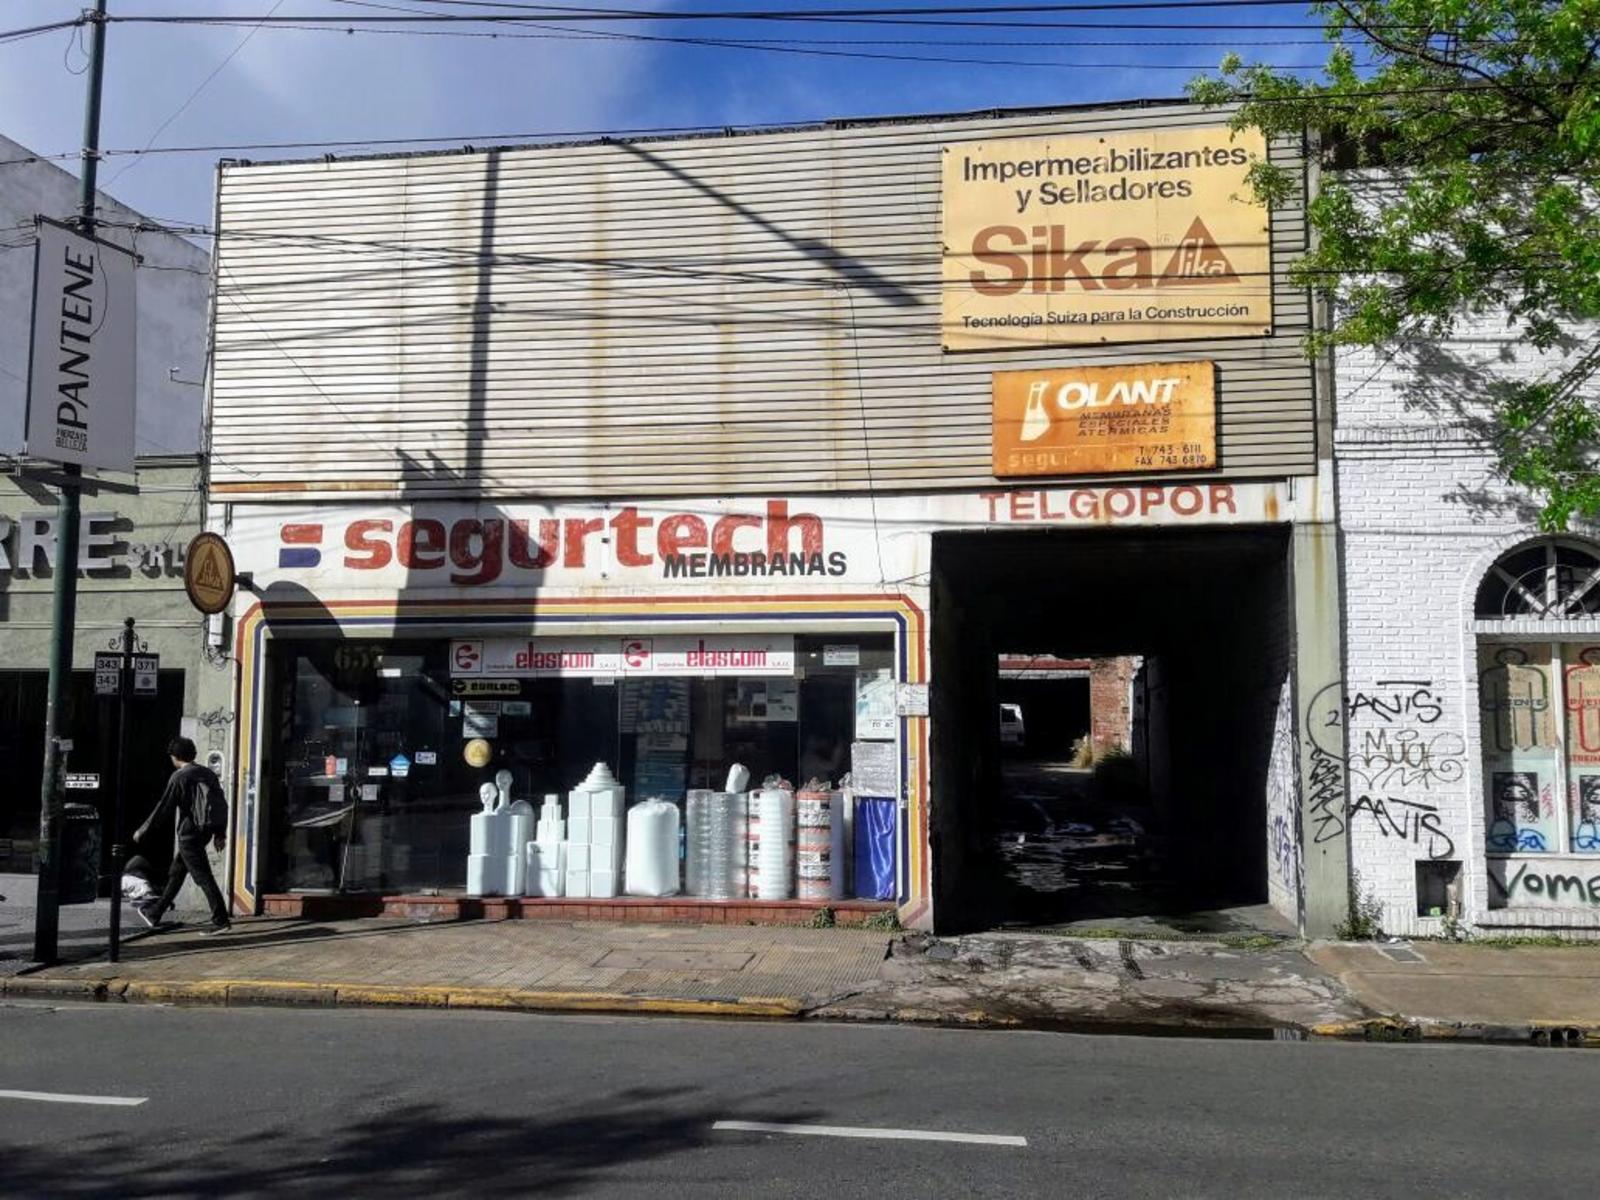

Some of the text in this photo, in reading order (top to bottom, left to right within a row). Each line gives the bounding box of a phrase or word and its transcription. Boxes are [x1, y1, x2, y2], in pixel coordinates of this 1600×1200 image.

[963, 147, 1247, 183] Impermeabilizantes
[1016, 177, 1192, 213] y Selladores
[970, 225, 1156, 297] Sika
[963, 303, 1249, 329] Tecnología Suiza para la Construcción
[57, 246, 94, 430] PANTENE
[1078, 426, 1168, 437] ATERMICAS
[1134, 456, 1153, 465] FAX
[981, 484, 1237, 525] TELGOPOR
[343, 499, 823, 585] segurtech
[663, 551, 847, 579] MEMBRANAS
